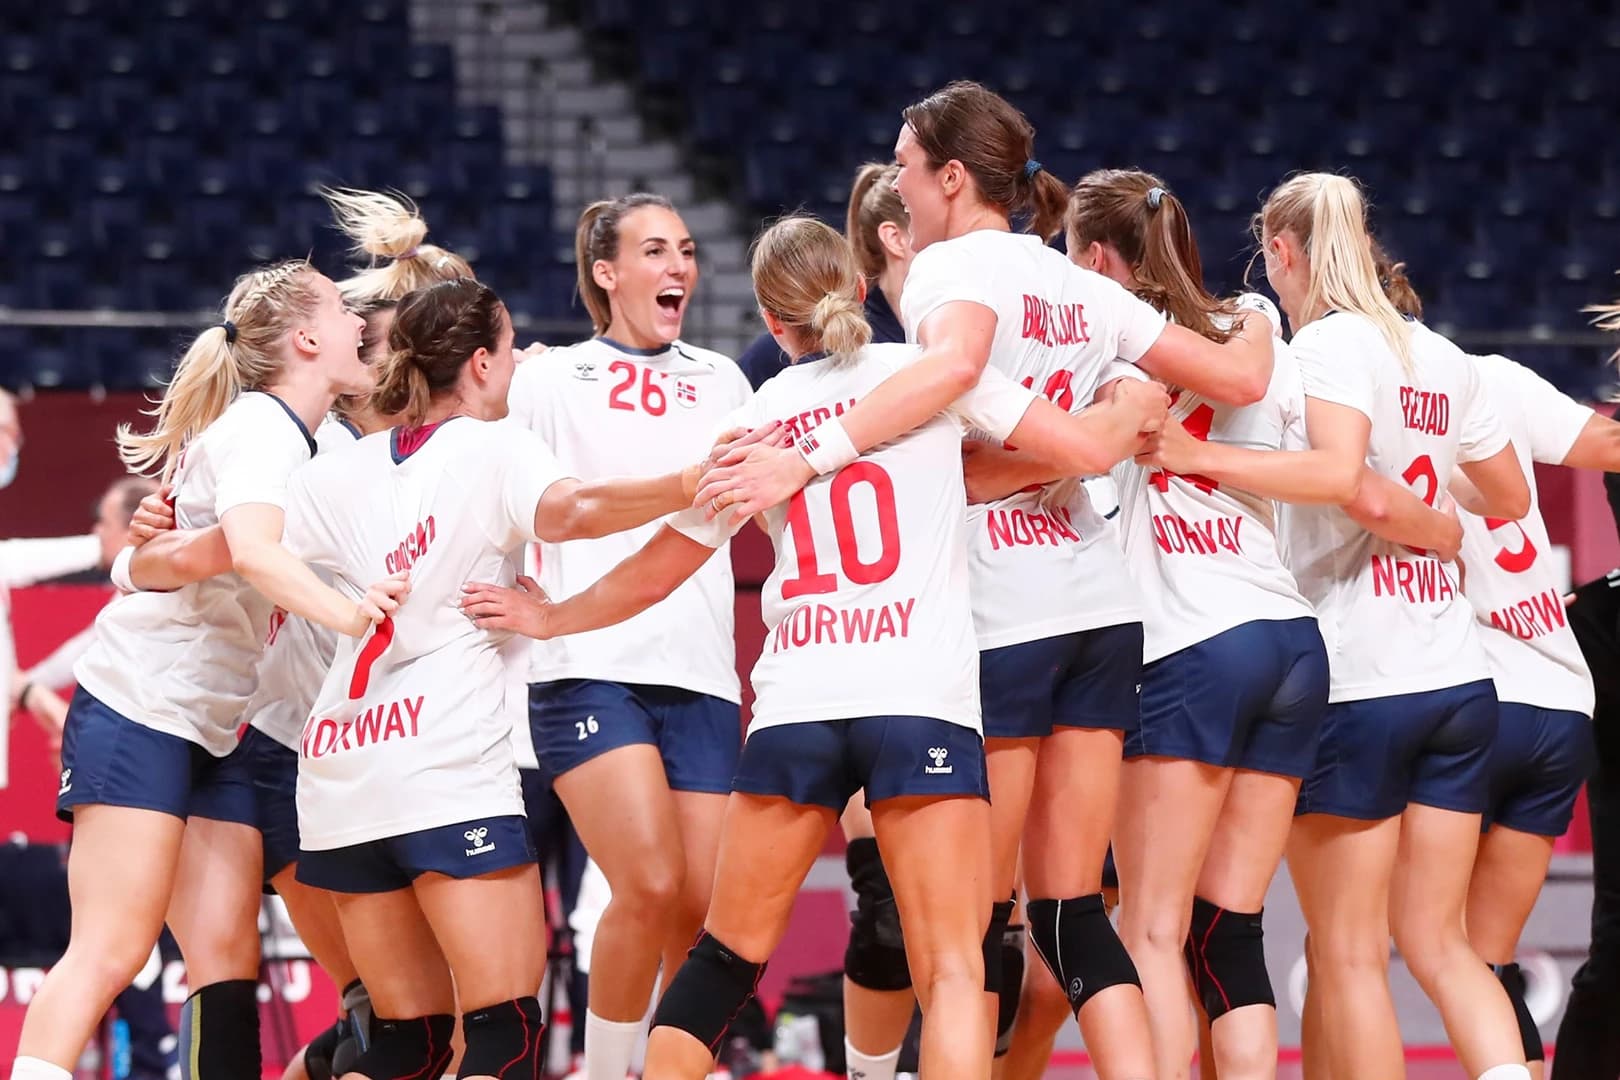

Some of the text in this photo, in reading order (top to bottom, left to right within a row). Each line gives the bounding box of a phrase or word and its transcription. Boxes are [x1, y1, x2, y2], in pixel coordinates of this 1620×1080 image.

[609, 361, 667, 416] 26
[781, 460, 901, 602] 10
[773, 598, 915, 652] NORWAY
[1490, 588, 1565, 640] NORW
[576, 716, 599, 741] 26
